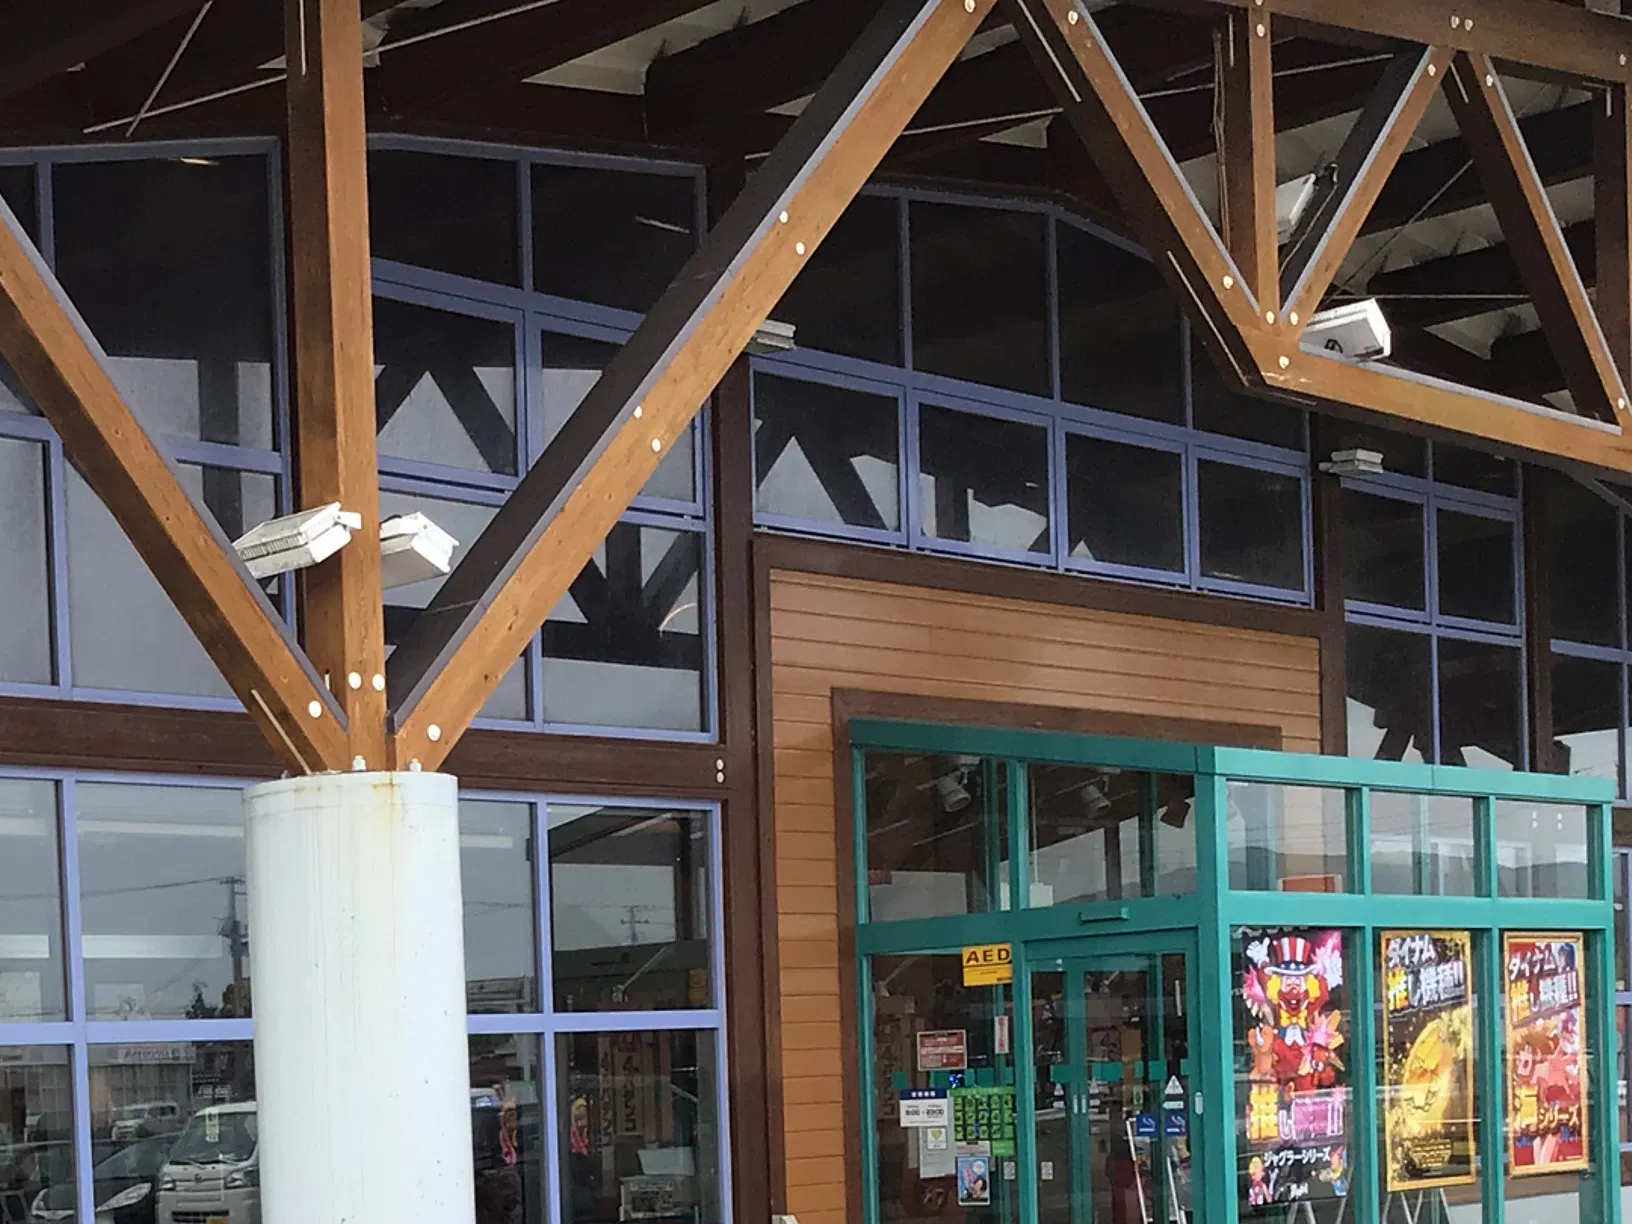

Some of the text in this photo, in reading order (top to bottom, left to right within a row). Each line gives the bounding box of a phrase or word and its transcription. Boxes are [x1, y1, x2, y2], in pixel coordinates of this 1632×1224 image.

[966, 948, 1010, 964] AED
[1388, 934, 1438, 969] ダイナム
[1509, 949, 1556, 980] ダイナム
[1264, 1147, 1331, 1168] ジャグラーシリーズ
